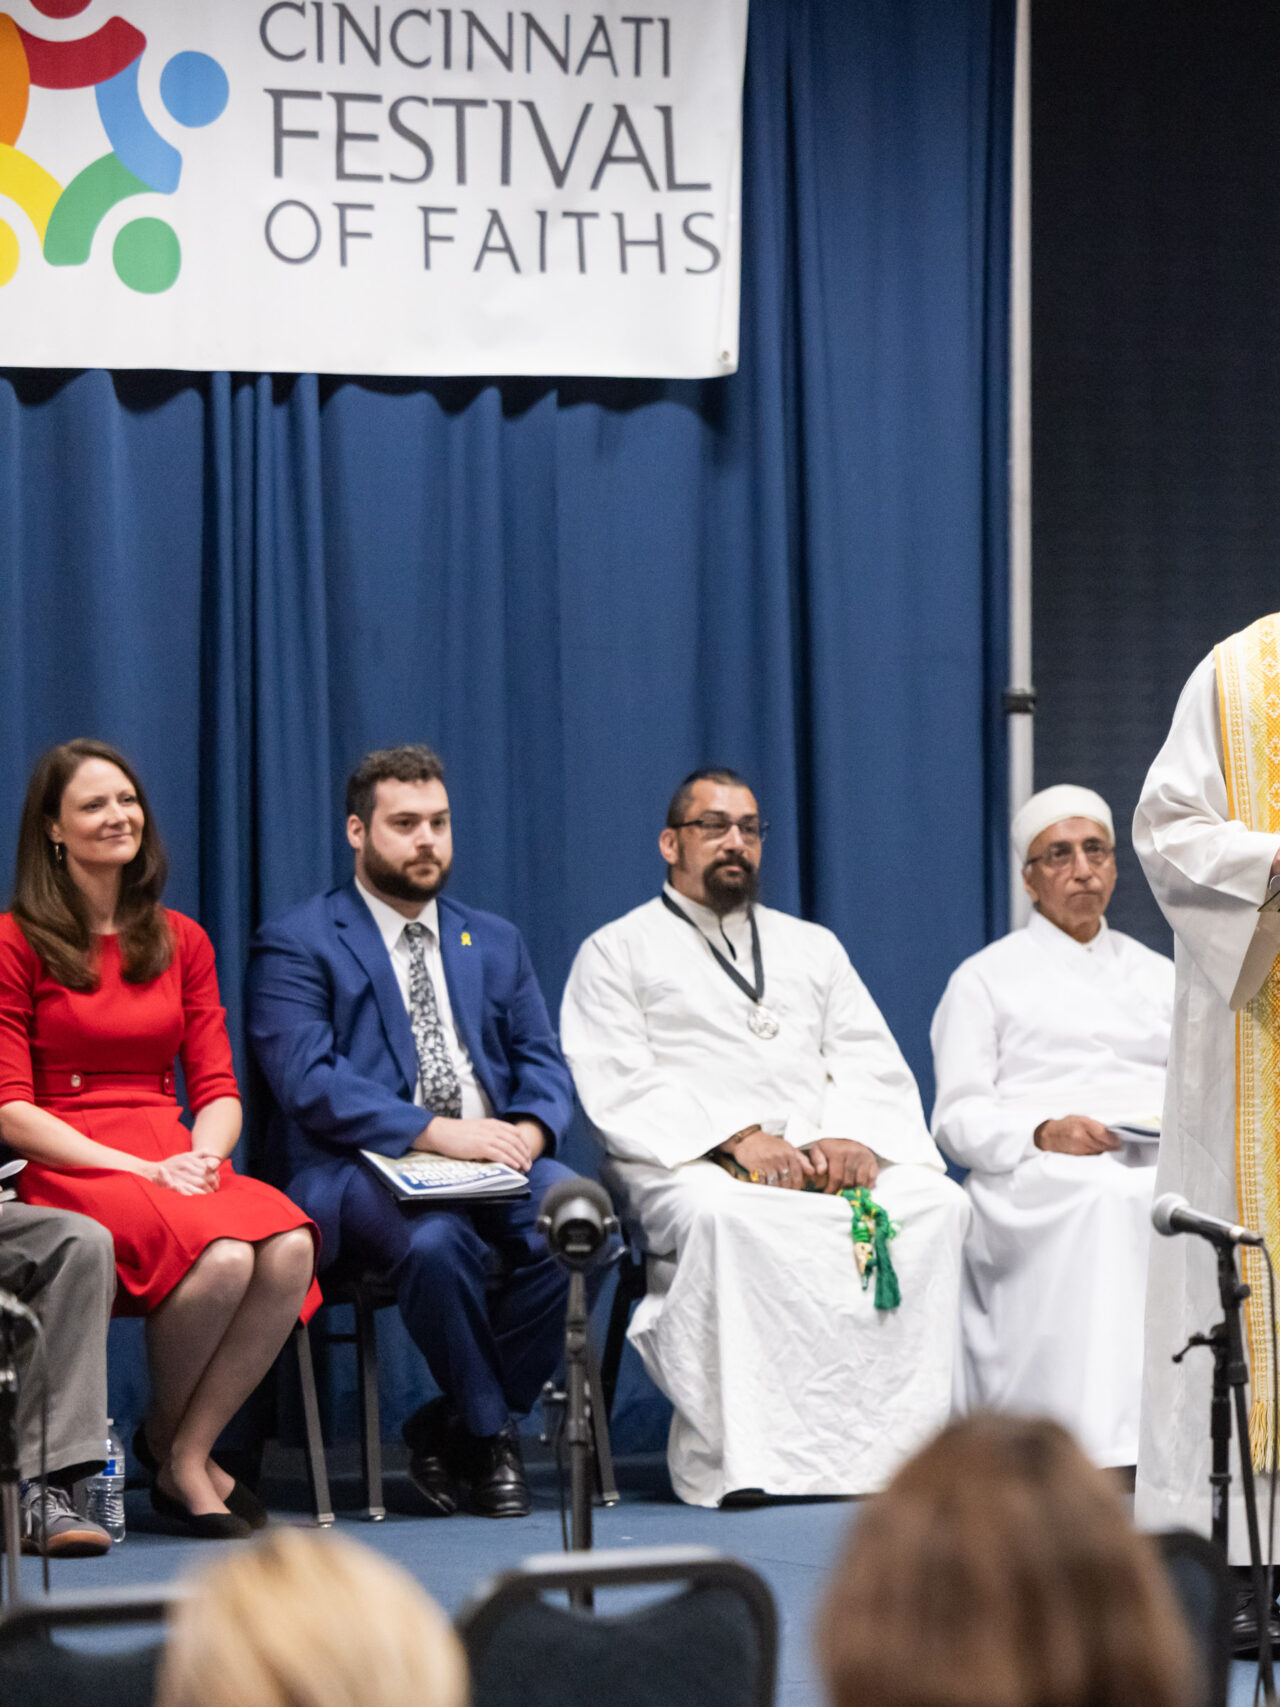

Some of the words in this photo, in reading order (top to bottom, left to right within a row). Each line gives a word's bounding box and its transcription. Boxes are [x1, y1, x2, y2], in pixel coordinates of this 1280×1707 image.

[259, 0, 671, 78] CINCINNATI
[263, 88, 711, 191] FESTIVAL
[264, 199, 374, 267] OF
[418, 205, 721, 274] FAITHS
